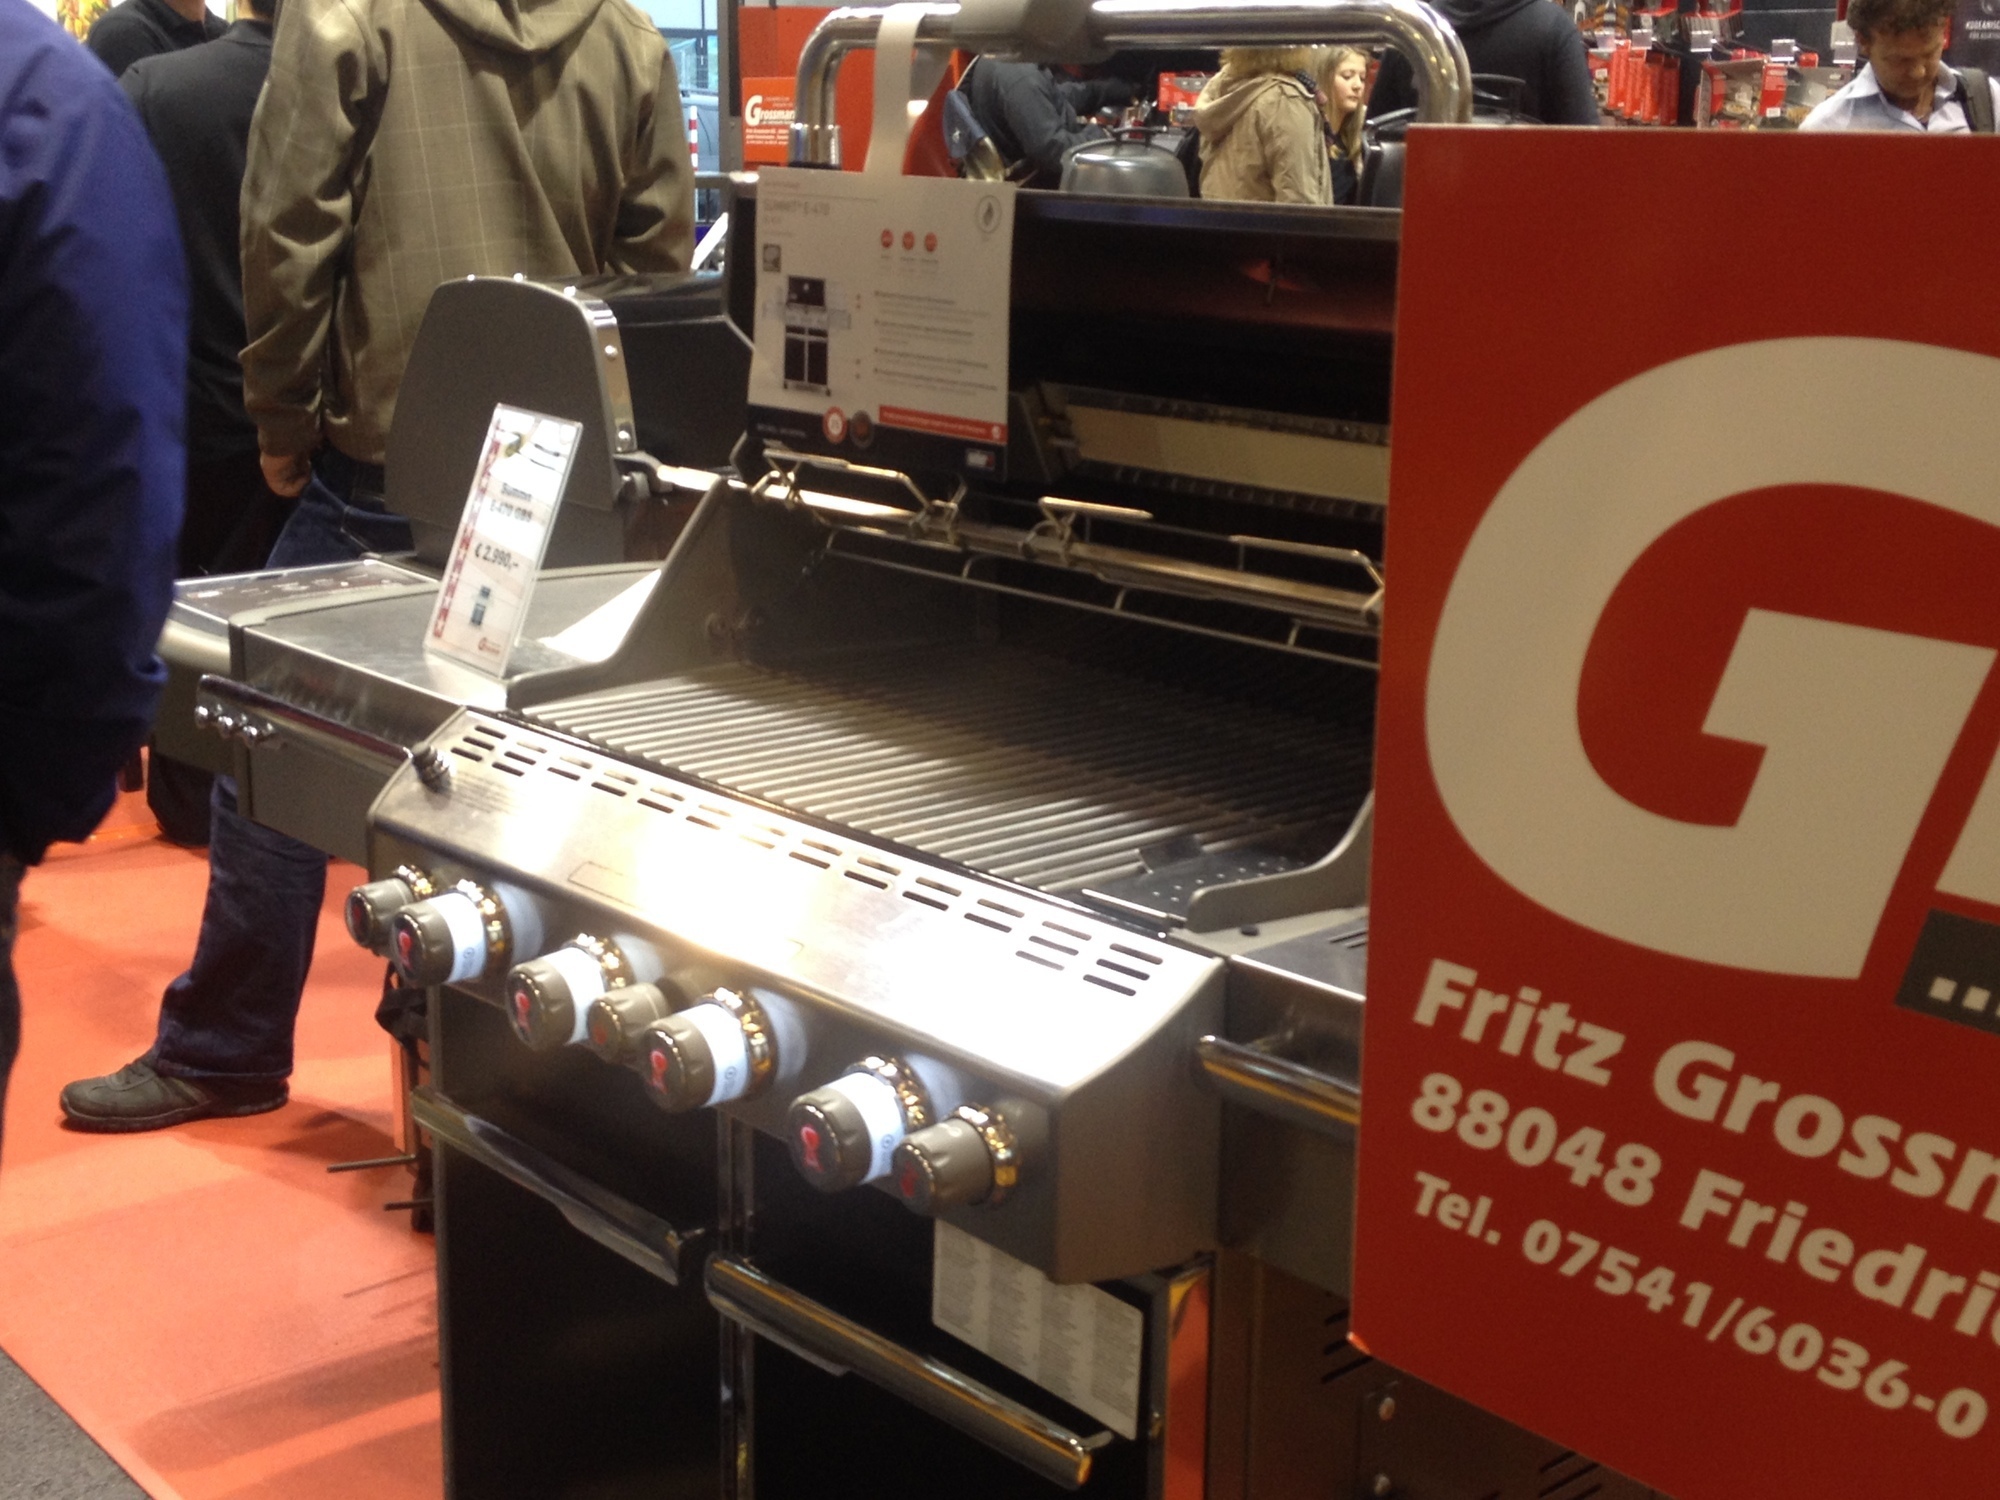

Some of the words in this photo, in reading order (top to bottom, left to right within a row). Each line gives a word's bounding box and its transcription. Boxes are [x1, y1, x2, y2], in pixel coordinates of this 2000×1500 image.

[1425, 337, 2000, 979] G
[1413, 958, 1625, 1086] Fritz
[1411, 1072, 1662, 1207] 88048
[1679, 1168, 2000, 1346] Friedri
[1414, 1171, 1501, 1245] Tel.
[1521, 1219, 1988, 1439] 07541/6036-0
